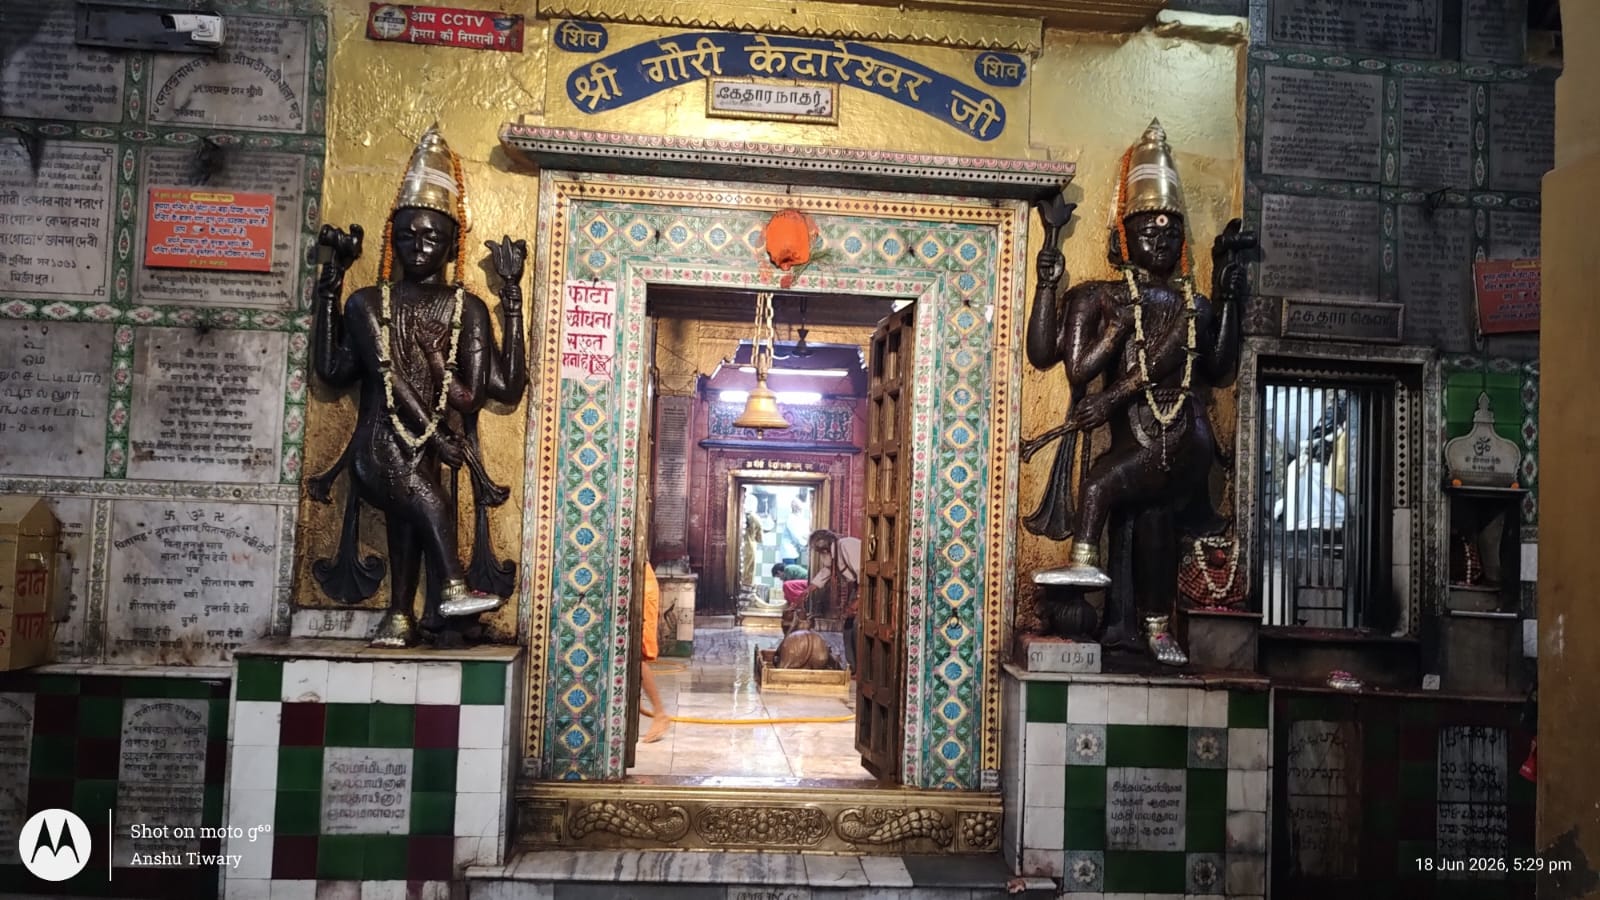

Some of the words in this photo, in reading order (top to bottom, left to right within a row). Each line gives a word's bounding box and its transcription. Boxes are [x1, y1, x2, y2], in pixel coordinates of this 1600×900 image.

[411, 12, 436, 23] आप
[441, 14, 485, 28] CCTV
[440, 27, 454, 41] की
[458, 30, 494, 45] निगरानी
[559, 26, 602, 49] शिव
[980, 56, 1021, 86] शिव
[574, 65, 623, 112] श्री
[642, 40, 725, 84] गौरी
[744, 36, 932, 101] केदारेश्वर
[951, 90, 999, 139] जी
[17, 569, 48, 597] दान
[16, 612, 47, 641] पात्र
